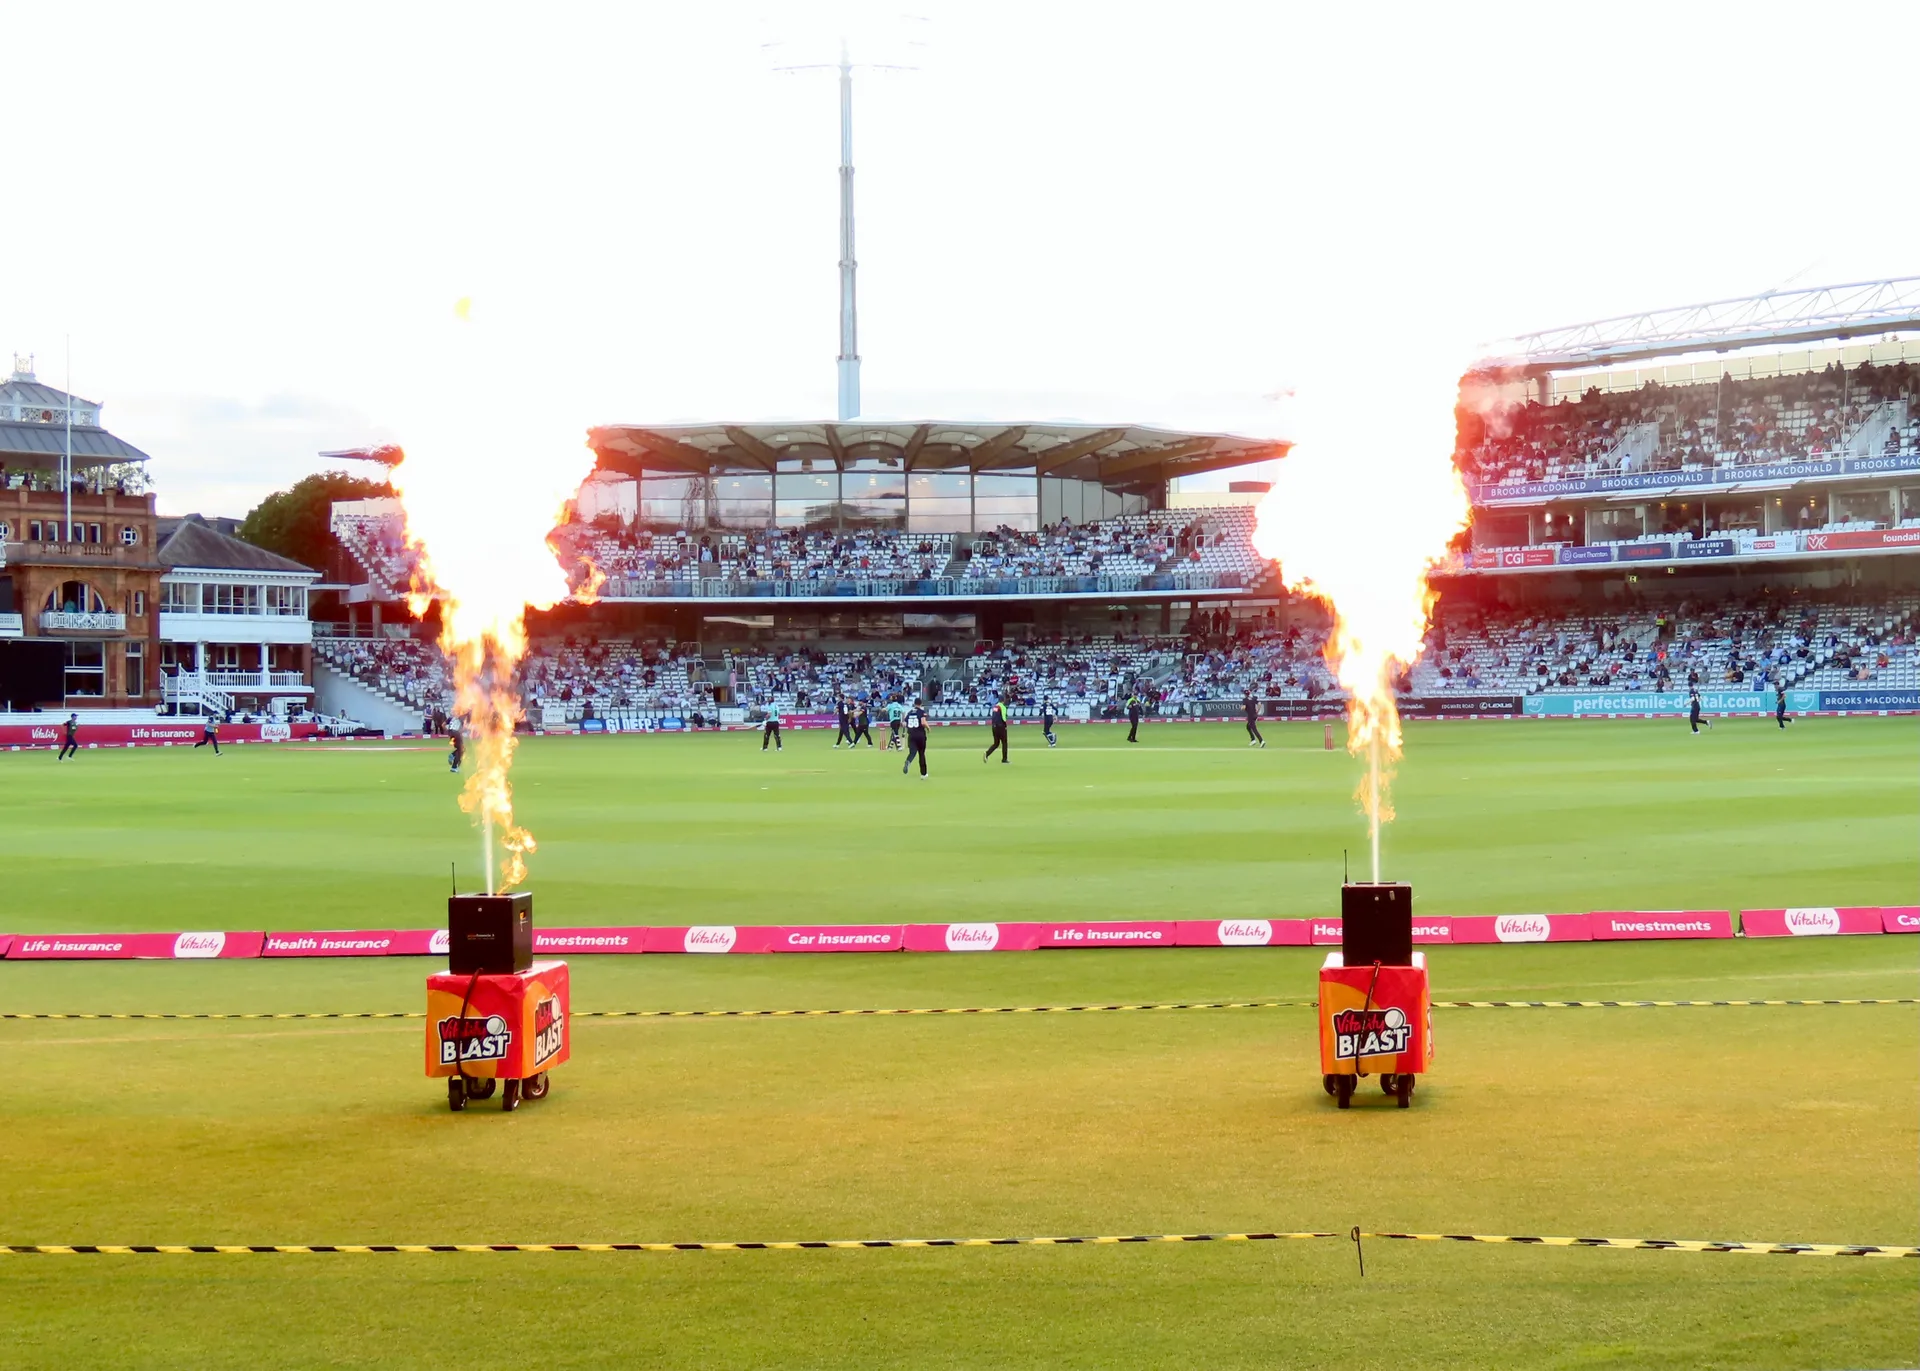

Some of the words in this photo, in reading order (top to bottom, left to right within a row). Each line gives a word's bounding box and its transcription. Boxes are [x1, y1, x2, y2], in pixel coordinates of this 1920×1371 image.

[1724, 468, 1764, 480] BROOKS
[1768, 463, 1833, 477] MACDONALD
[1854, 459, 1896, 470] BROOKS
[1601, 478, 1640, 488] BROOKS
[1643, 473, 1704, 486] MACDONALD
[1491, 487, 1526, 497] BROOKS
[1529, 481, 1587, 494] MACDONALD
[1505, 553, 1524, 564] CGI
[625, 579, 656, 597] DEEP
[707, 579, 735, 597] DEEP
[790, 580, 818, 597] DEEP
[872, 580, 899, 596] DEEP
[952, 578, 979, 595] DEEP
[1033, 577, 1060, 593] DEEP
[1112, 575, 1138, 591] DEEP
[1189, 573, 1215, 589] DEEP
[1205, 703, 1241, 712] WOODSTO
[1573, 695, 1761, 712] perfectsmile-dtal.com
[1825, 697, 1862, 705] BROOKS
[32, 726, 58, 742] Vitality
[132, 728, 150, 738] Life
[151, 728, 195, 738] insurance
[264, 726, 288, 739] Vitality
[1500, 919, 1545, 936] Vitality
[1611, 920, 1712, 932] Investments
[1790, 911, 1834, 929] Vitality
[1897, 915, 1920, 926] Ca
[951, 927, 993, 944] Vitality
[1053, 930, 1084, 940] Life
[1087, 929, 1162, 939] insurance
[1223, 924, 1267, 940] Vitality
[1313, 924, 1343, 936] Hea
[22, 941, 50, 952] Life
[53, 942, 122, 952] insurance
[180, 936, 220, 951] Vitality
[267, 938, 317, 950] Health
[320, 938, 390, 949] insurance
[535, 934, 628, 946] Investments
[690, 930, 730, 947] Vitality
[788, 933, 816, 945] Car
[818, 933, 891, 944] insurance
[440, 1018, 487, 1041] Vitlity
[1336, 1012, 1385, 1034] Vitaity
[443, 1035, 507, 1062] BLAST
[536, 1019, 563, 1064] BLAST
[1339, 1028, 1408, 1057] BLAST
